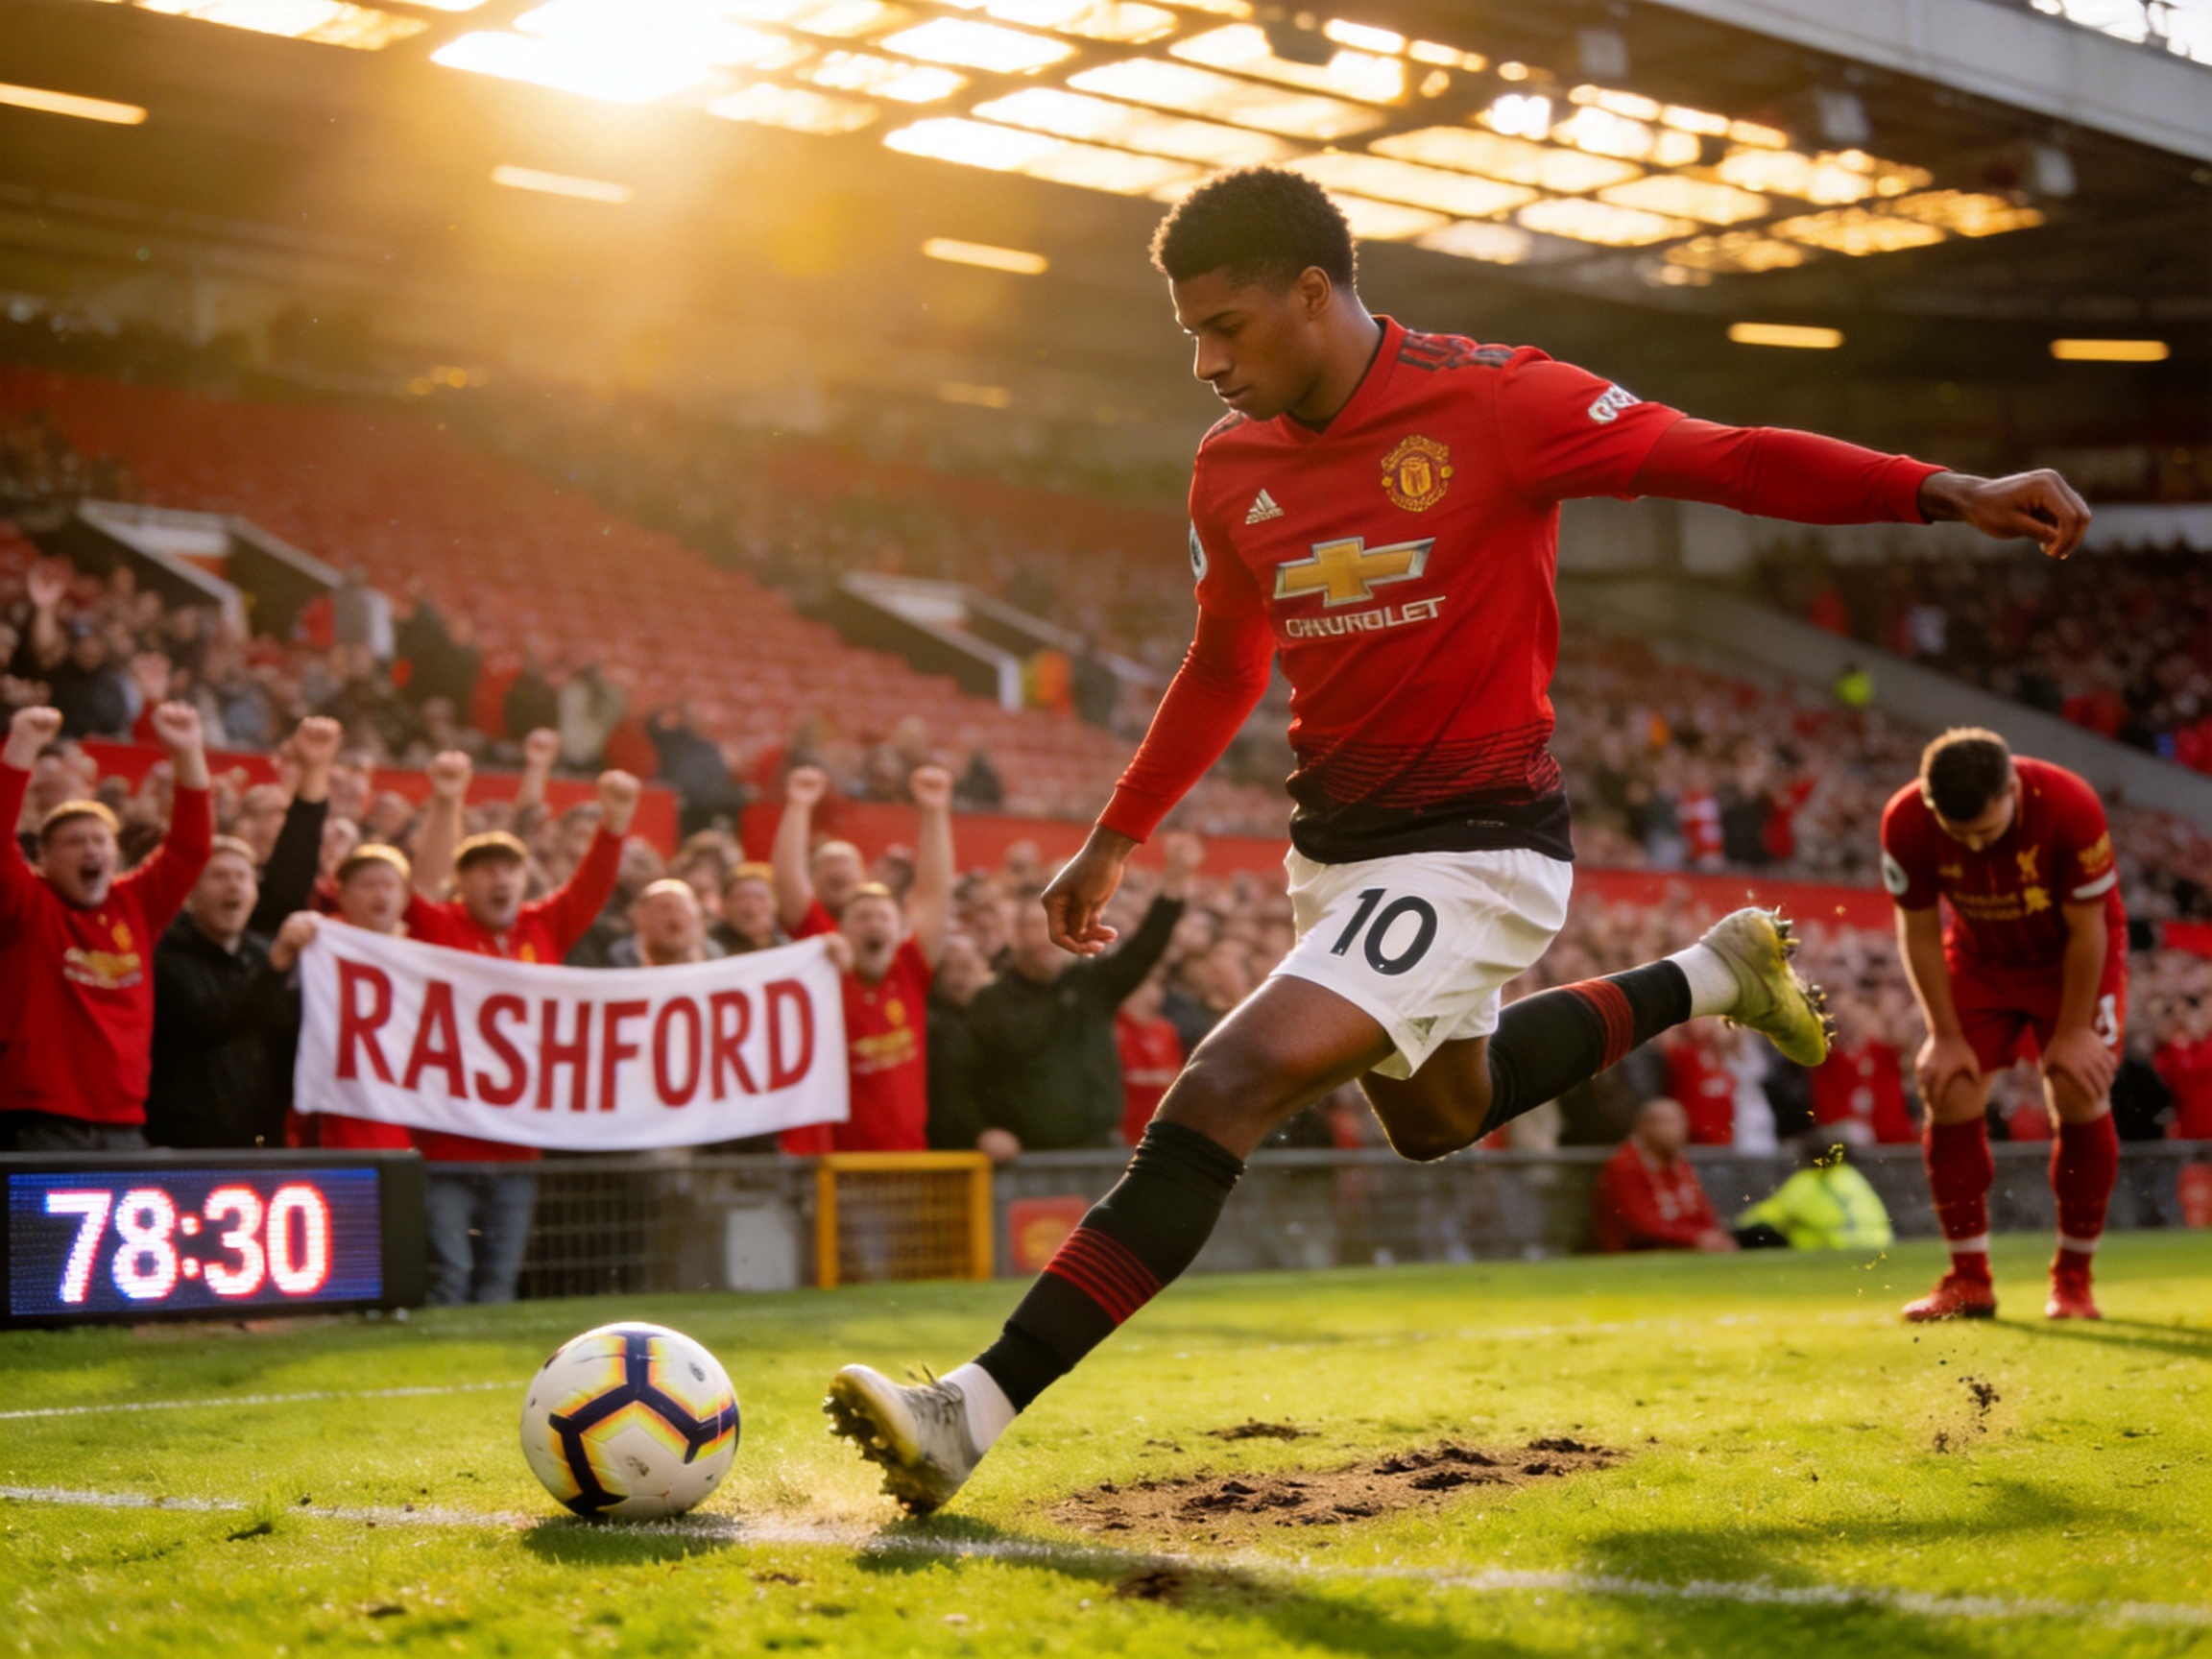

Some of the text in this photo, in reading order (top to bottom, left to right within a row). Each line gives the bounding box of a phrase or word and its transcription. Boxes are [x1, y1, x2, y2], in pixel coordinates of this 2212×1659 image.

[1331, 888, 1437, 975] 10
[336, 955, 815, 1113] RASHFORD
[45, 1183, 330, 1304] 78:30
